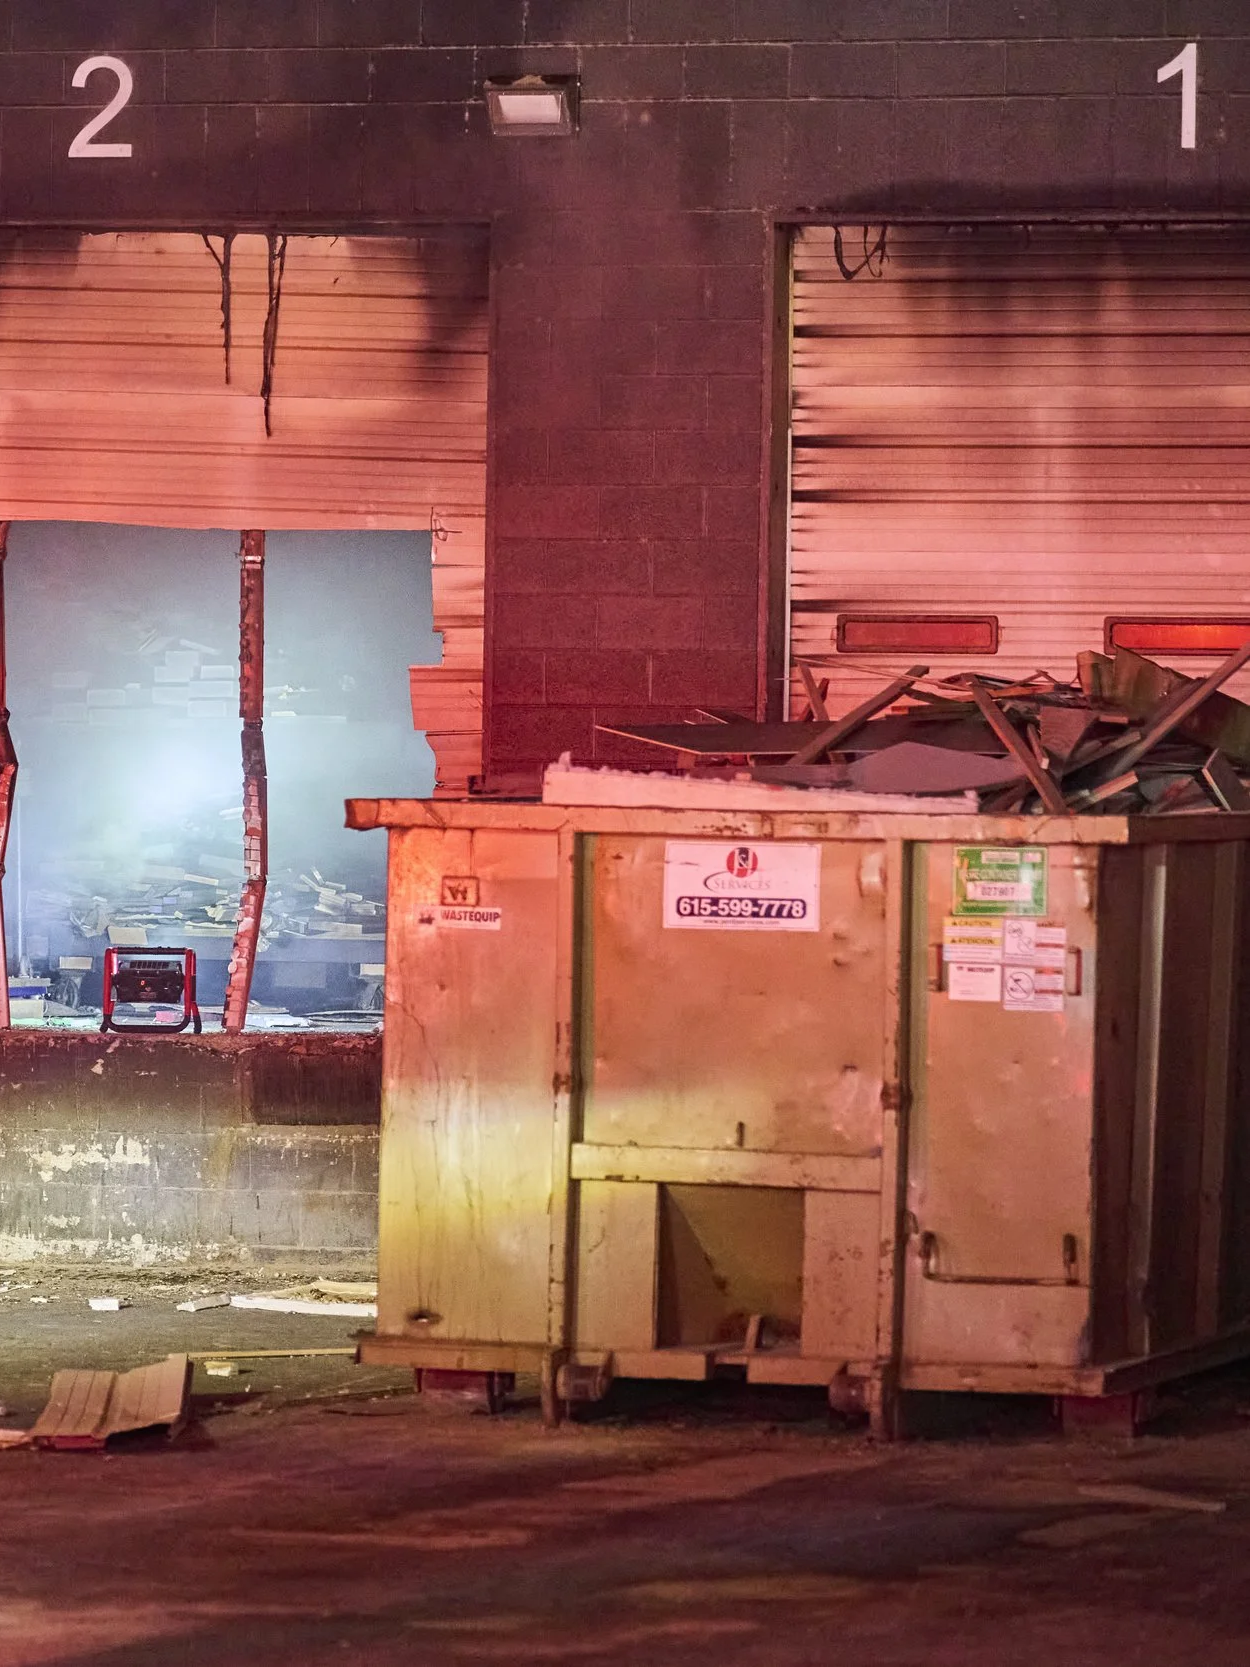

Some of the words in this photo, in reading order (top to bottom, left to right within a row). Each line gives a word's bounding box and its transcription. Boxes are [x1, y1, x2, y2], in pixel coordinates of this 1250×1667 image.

[67, 55, 133, 158] 2
[1156, 42, 1197, 149] 1
[712, 876, 772, 891] SERVICES
[441, 909, 500, 923] WASTEQUIP
[678, 896, 805, 918] 615-599-7778
